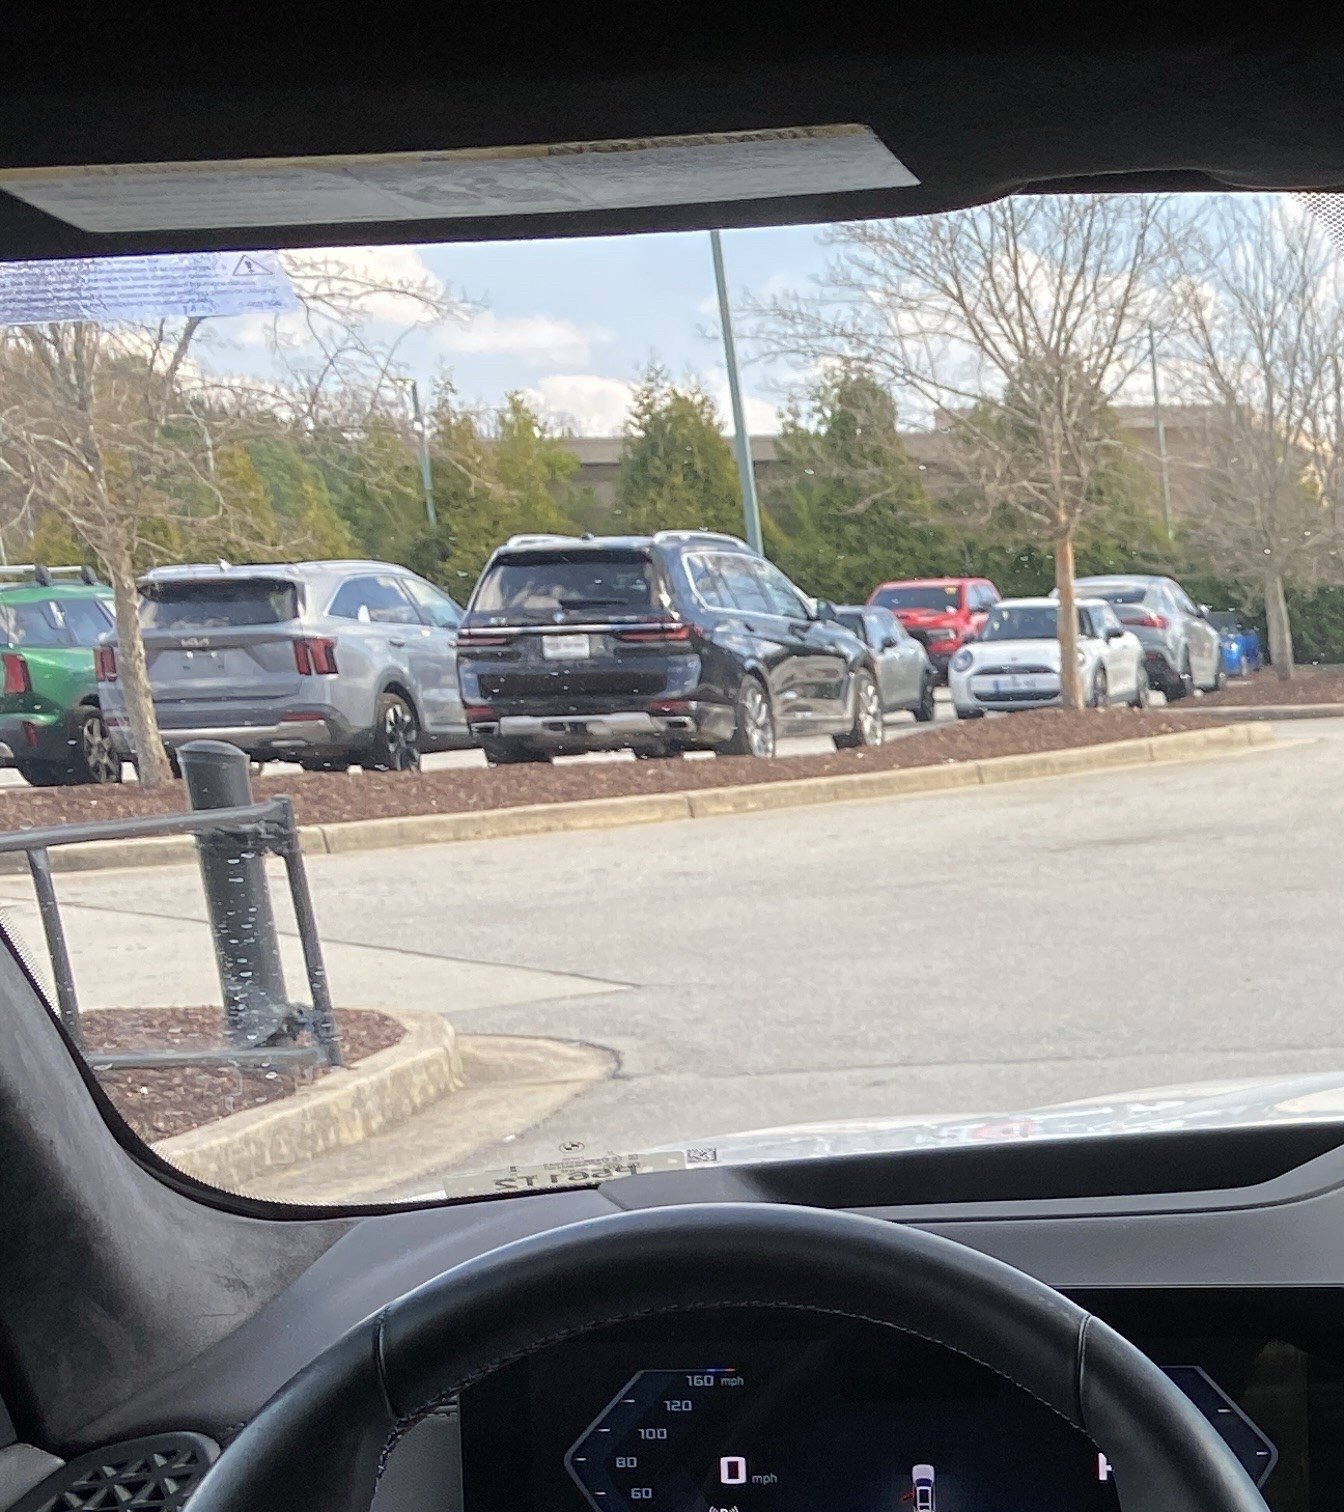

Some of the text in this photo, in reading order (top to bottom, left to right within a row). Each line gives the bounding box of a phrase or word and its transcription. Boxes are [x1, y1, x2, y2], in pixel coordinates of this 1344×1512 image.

[686, 1376, 744, 1386] 160 mph
[664, 1400, 692, 1411] 120
[638, 1429, 667, 1439] 100
[616, 1457, 637, 1468] 80
[720, 1456, 778, 1485] 0 mph
[631, 1488, 652, 1499] 60
